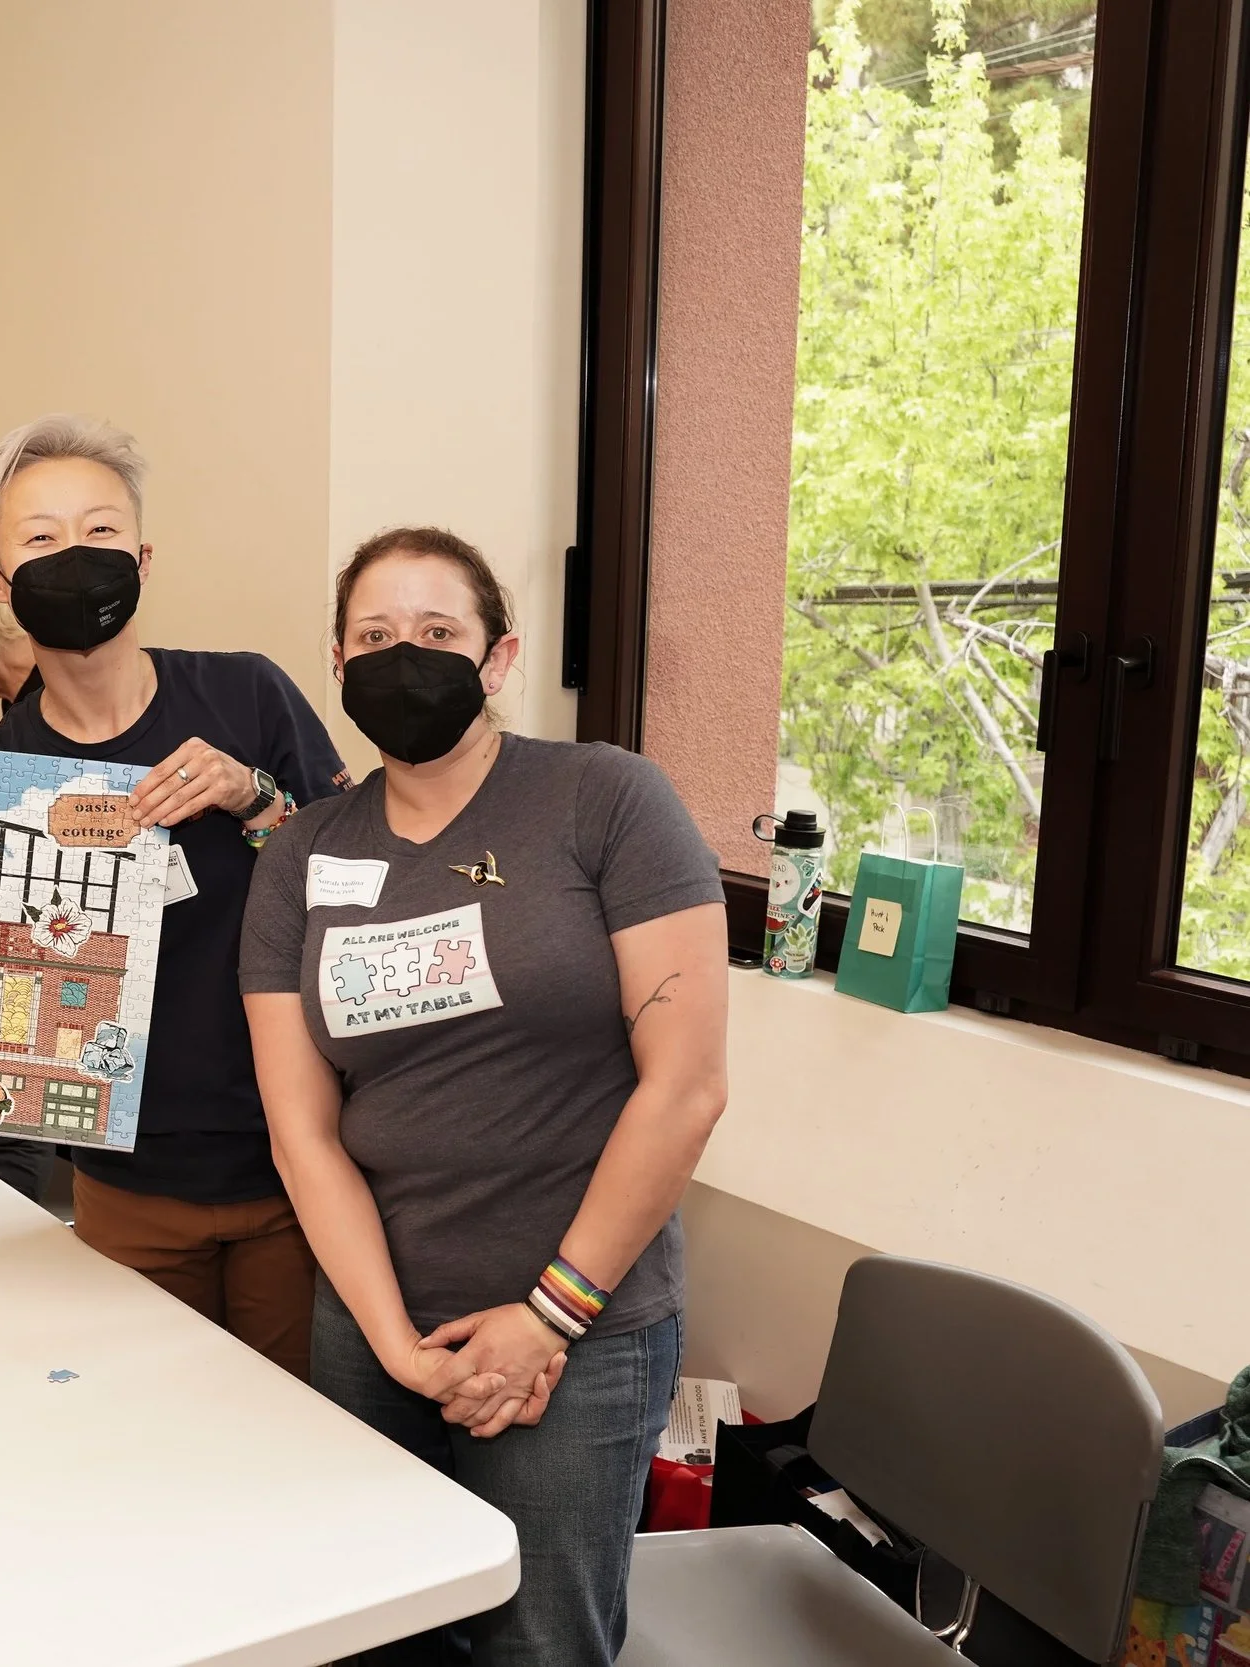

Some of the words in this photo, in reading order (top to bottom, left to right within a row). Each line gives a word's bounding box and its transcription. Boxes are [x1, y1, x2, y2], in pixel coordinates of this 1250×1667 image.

[75, 800, 117, 813] oasis
[61, 828, 124, 841] cottage
[342, 936, 366, 946] ALL
[368, 932, 395, 943] ARE
[397, 919, 460, 939] WELCOME
[346, 1010, 371, 1027] AT
[374, 1004, 403, 1022] MY
[406, 991, 473, 1016] TABLE
[697, 1404, 704, 1412] DO
[700, 1428, 708, 1444] HAVE
